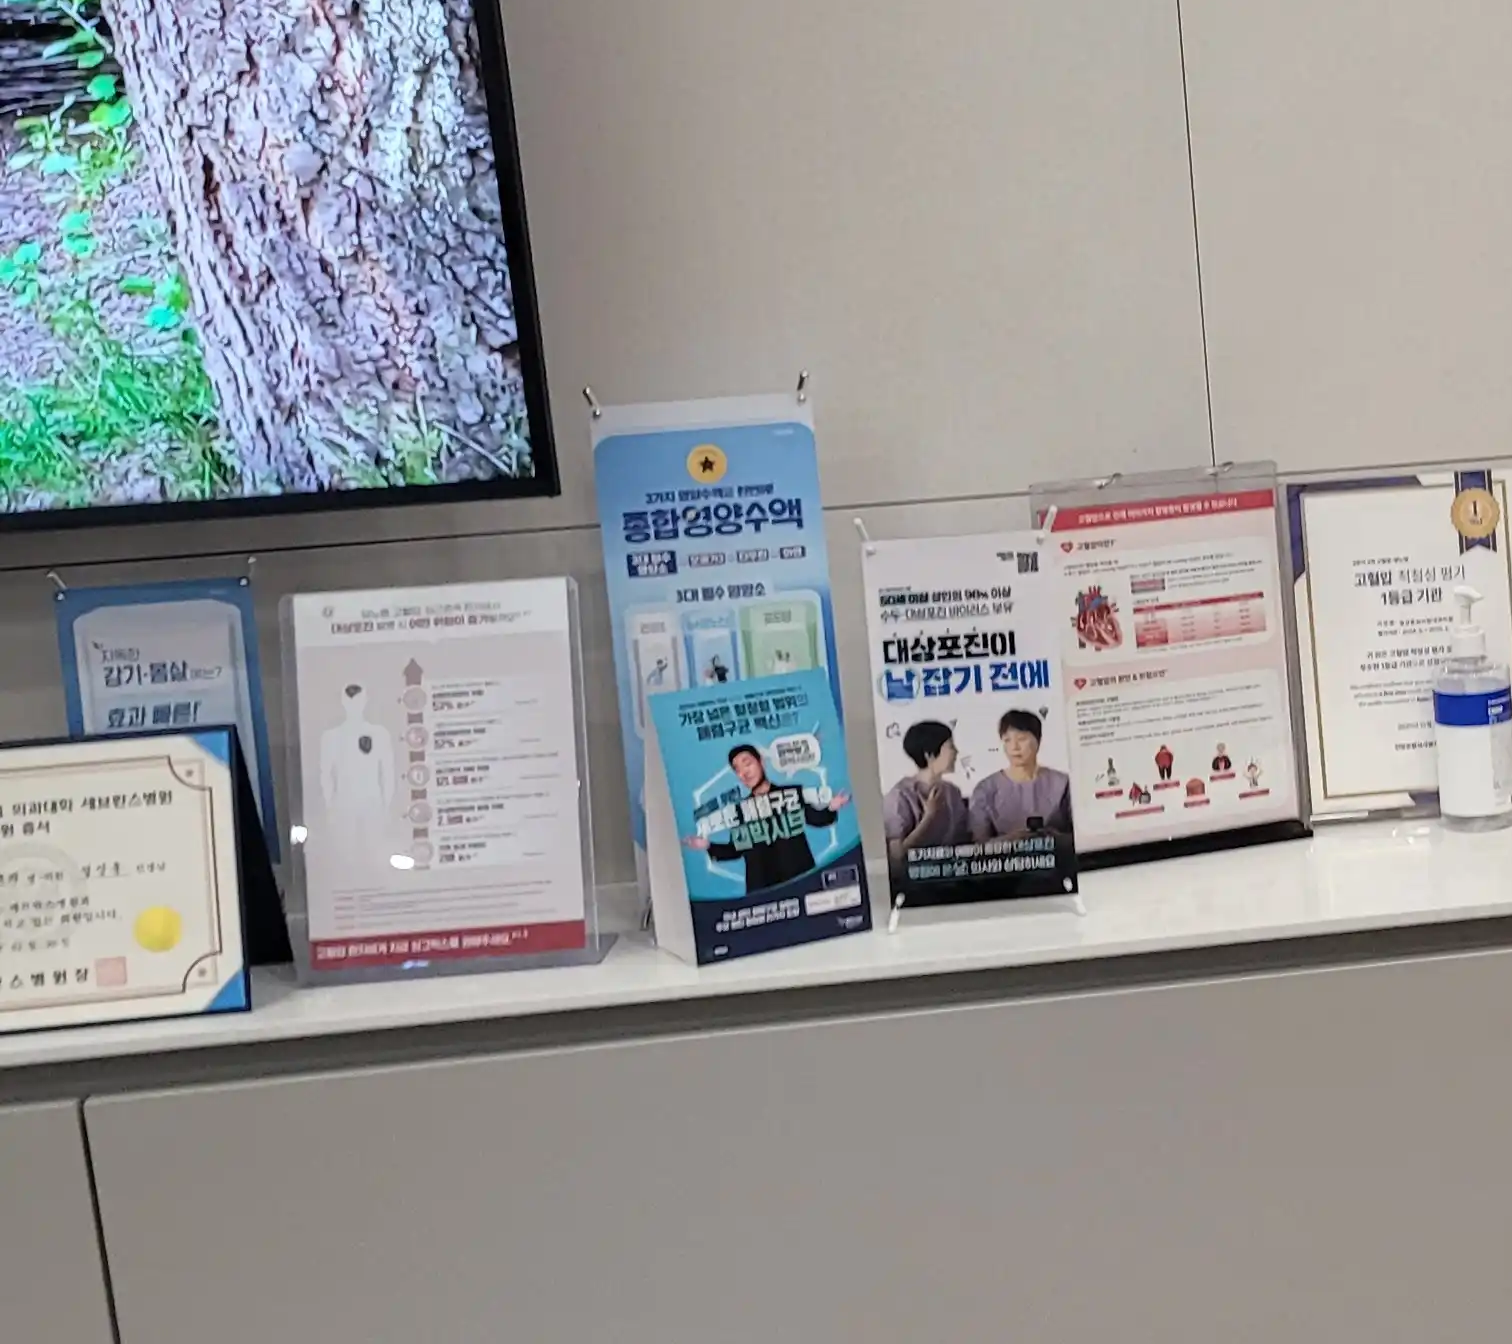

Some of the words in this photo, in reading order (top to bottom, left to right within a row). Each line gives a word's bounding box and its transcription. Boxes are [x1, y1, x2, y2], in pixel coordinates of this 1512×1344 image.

[622, 497, 804, 543] 종합영양수액
[883, 630, 1016, 665] 대상포진이
[922, 664, 982, 698] 잡기
[989, 659, 1050, 692] 전에
[108, 705, 145, 729] 효과
[80, 789, 173, 811] 세브란스병원
